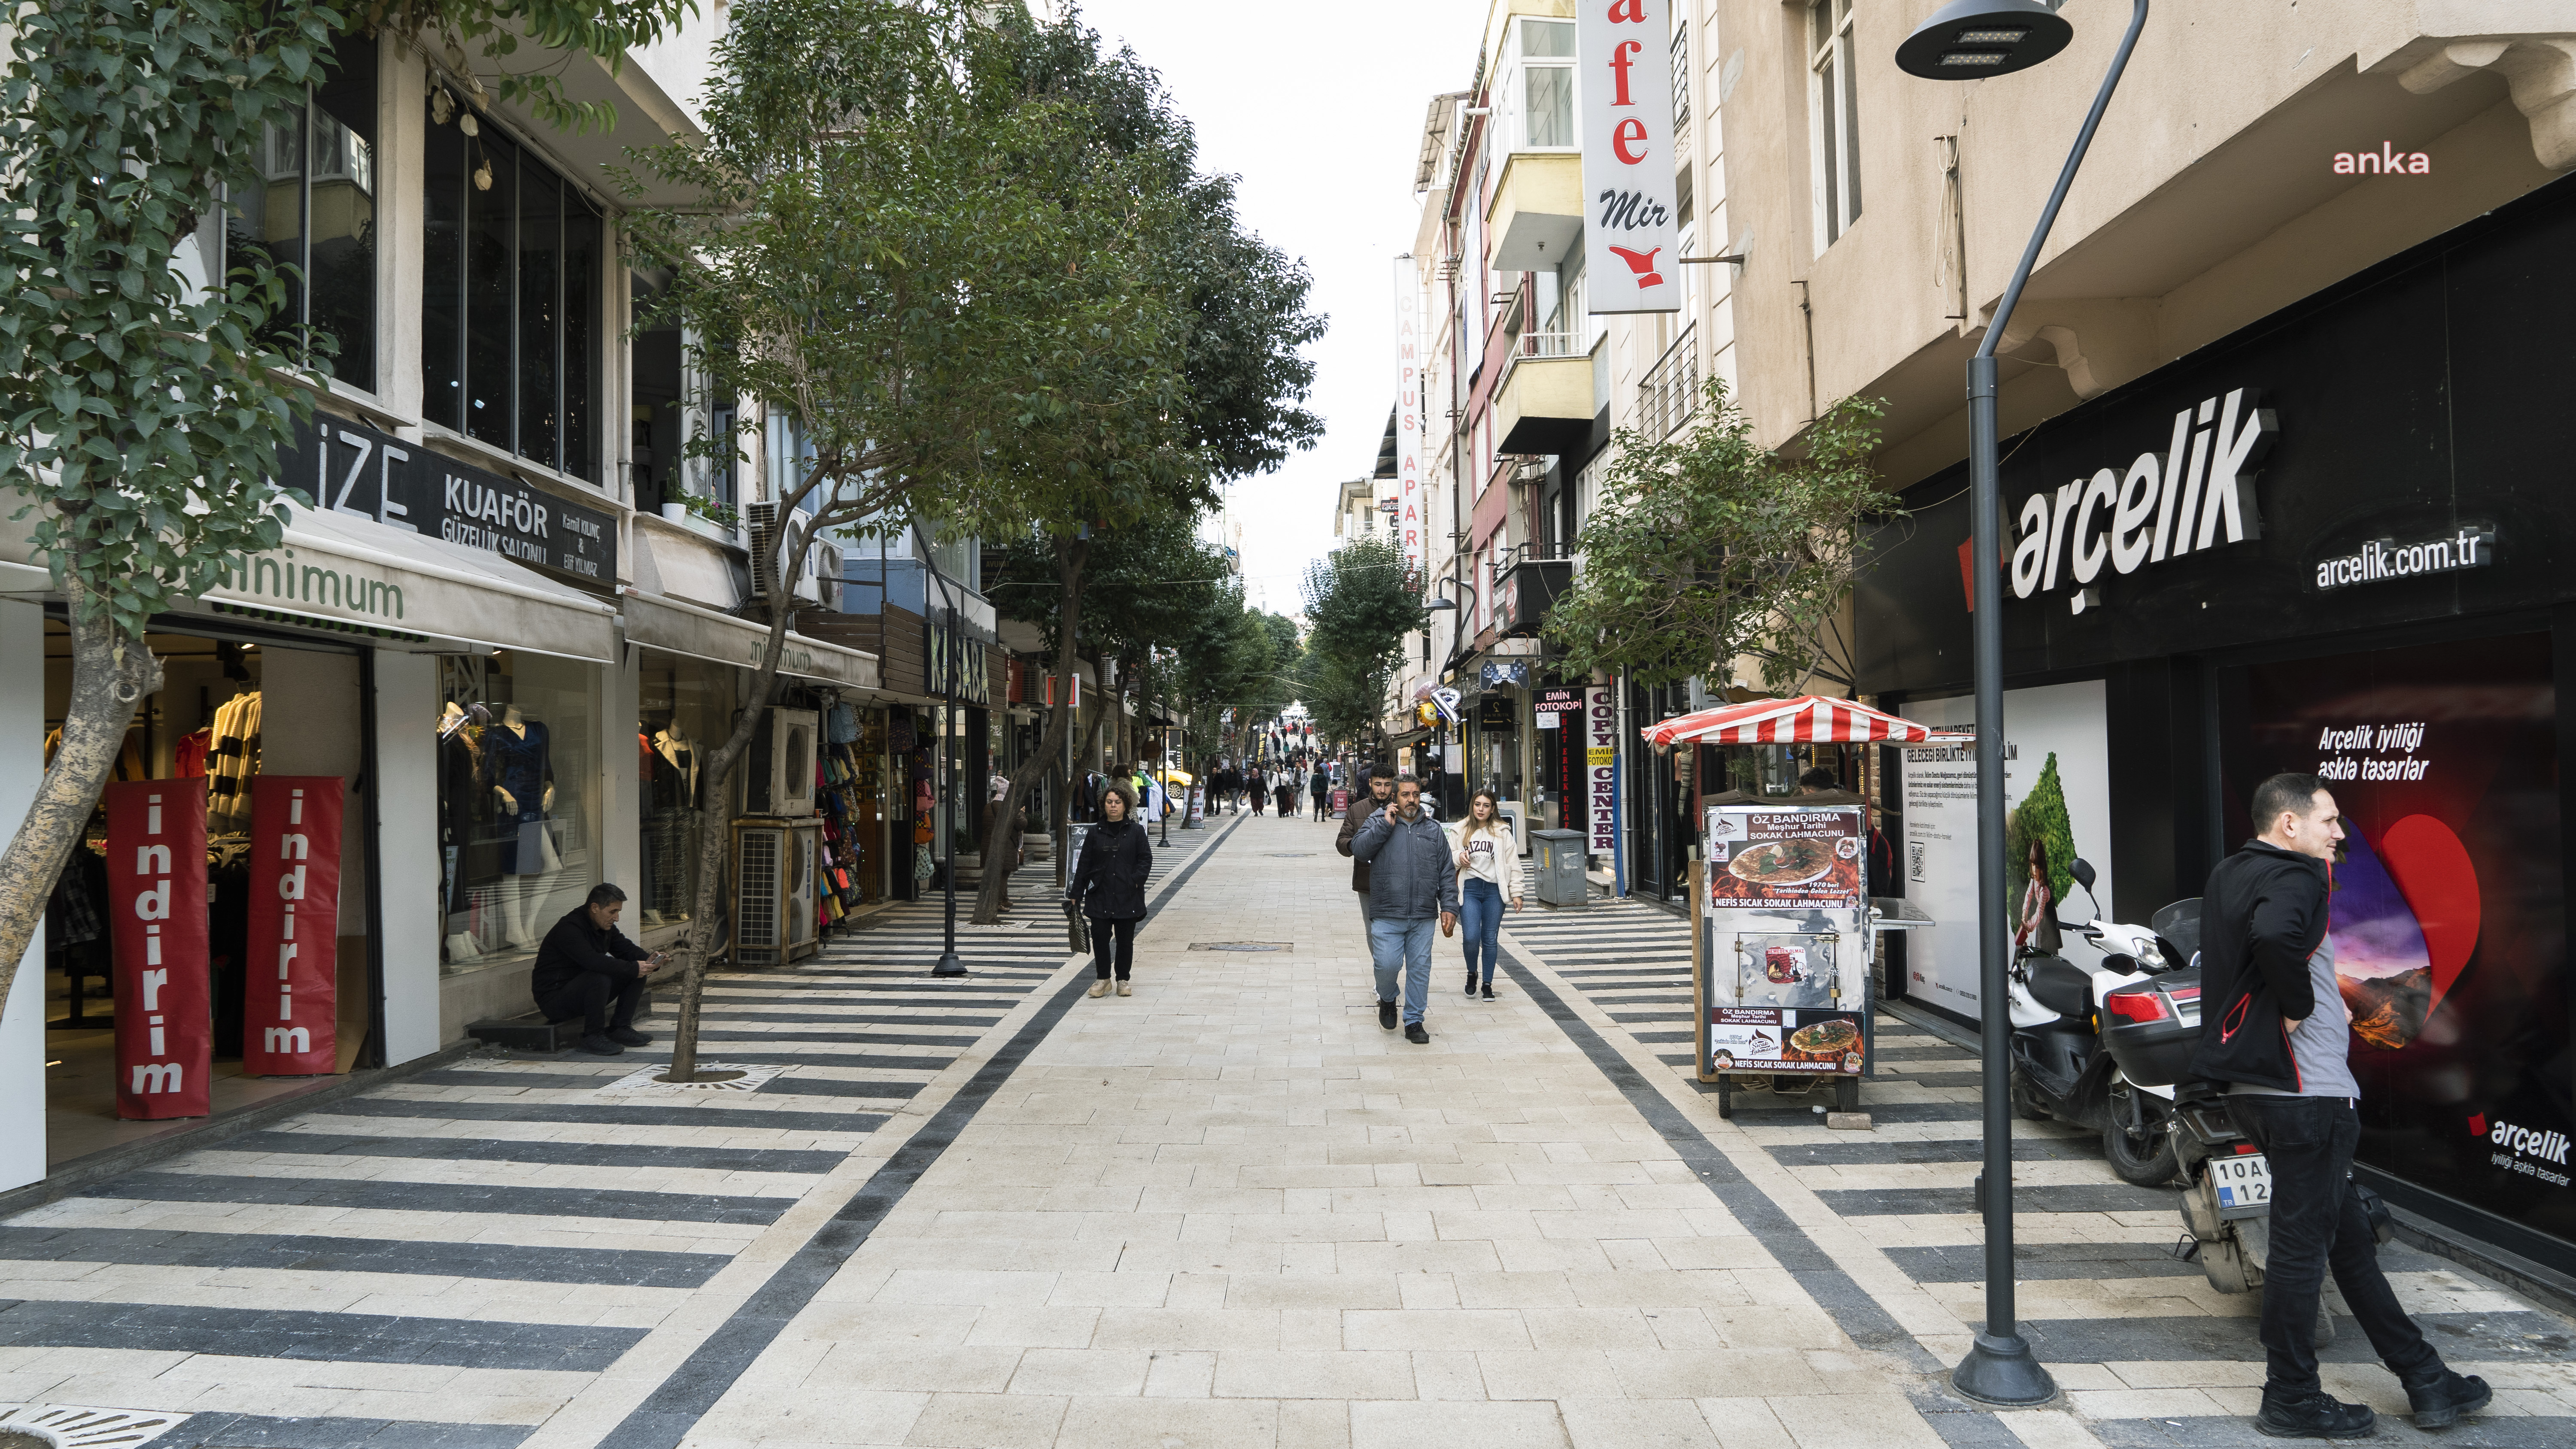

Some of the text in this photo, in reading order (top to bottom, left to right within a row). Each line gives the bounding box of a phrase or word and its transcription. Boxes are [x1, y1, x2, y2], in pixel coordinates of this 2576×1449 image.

[1600, 190, 1669, 230] Mir
[1400, 296, 1415, 431] CAMPUS
[445, 474, 548, 538] KUAFÖR
[2011, 387, 2263, 615] arçelik
[442, 515, 500, 553] GÜZELLİK
[562, 513, 600, 542] Kamil KILINÇ
[578, 538, 584, 554] &
[2317, 530, 2480, 587] arcelik.com.tr
[564, 553, 598, 577] Elif YILMAZ
[220, 549, 403, 620] inimum
[750, 637, 811, 672] mimum
[1535, 699, 1582, 712] FOTOKOPİ
[1546, 690, 1570, 700] EMİN
[1592, 692, 1613, 746] COPY
[1935, 744, 1964, 762] BİRLİKTE
[2318, 722, 2425, 755] Arçelik iyiliği
[1588, 756, 1612, 766] FOTOKO
[2362, 756, 2430, 780] tasarlar
[1593, 767, 1614, 849] CENTER
[1752, 813, 1841, 824] ÖZ BANDIRMA
[1767, 823, 1800, 831] Meşhur
[1785, 830, 1844, 838] LAHMACUNU
[1464, 840, 1495, 861] RIZON
[1716, 897, 1843, 908] NEFİS SICAK SOKAK LAHMACUNU
[264, 789, 310, 1054] indirim
[132, 794, 183, 1094] indirim
[1735, 1059, 1753, 1068] NEFİS
[1774, 1061, 1795, 1069] SOKAK
[1749, 1045, 1780, 1056] Lahmacun
[2491, 1121, 2571, 1165] arçelik
[2491, 1152, 2571, 1187] iyiliği aşkla tasarlar
